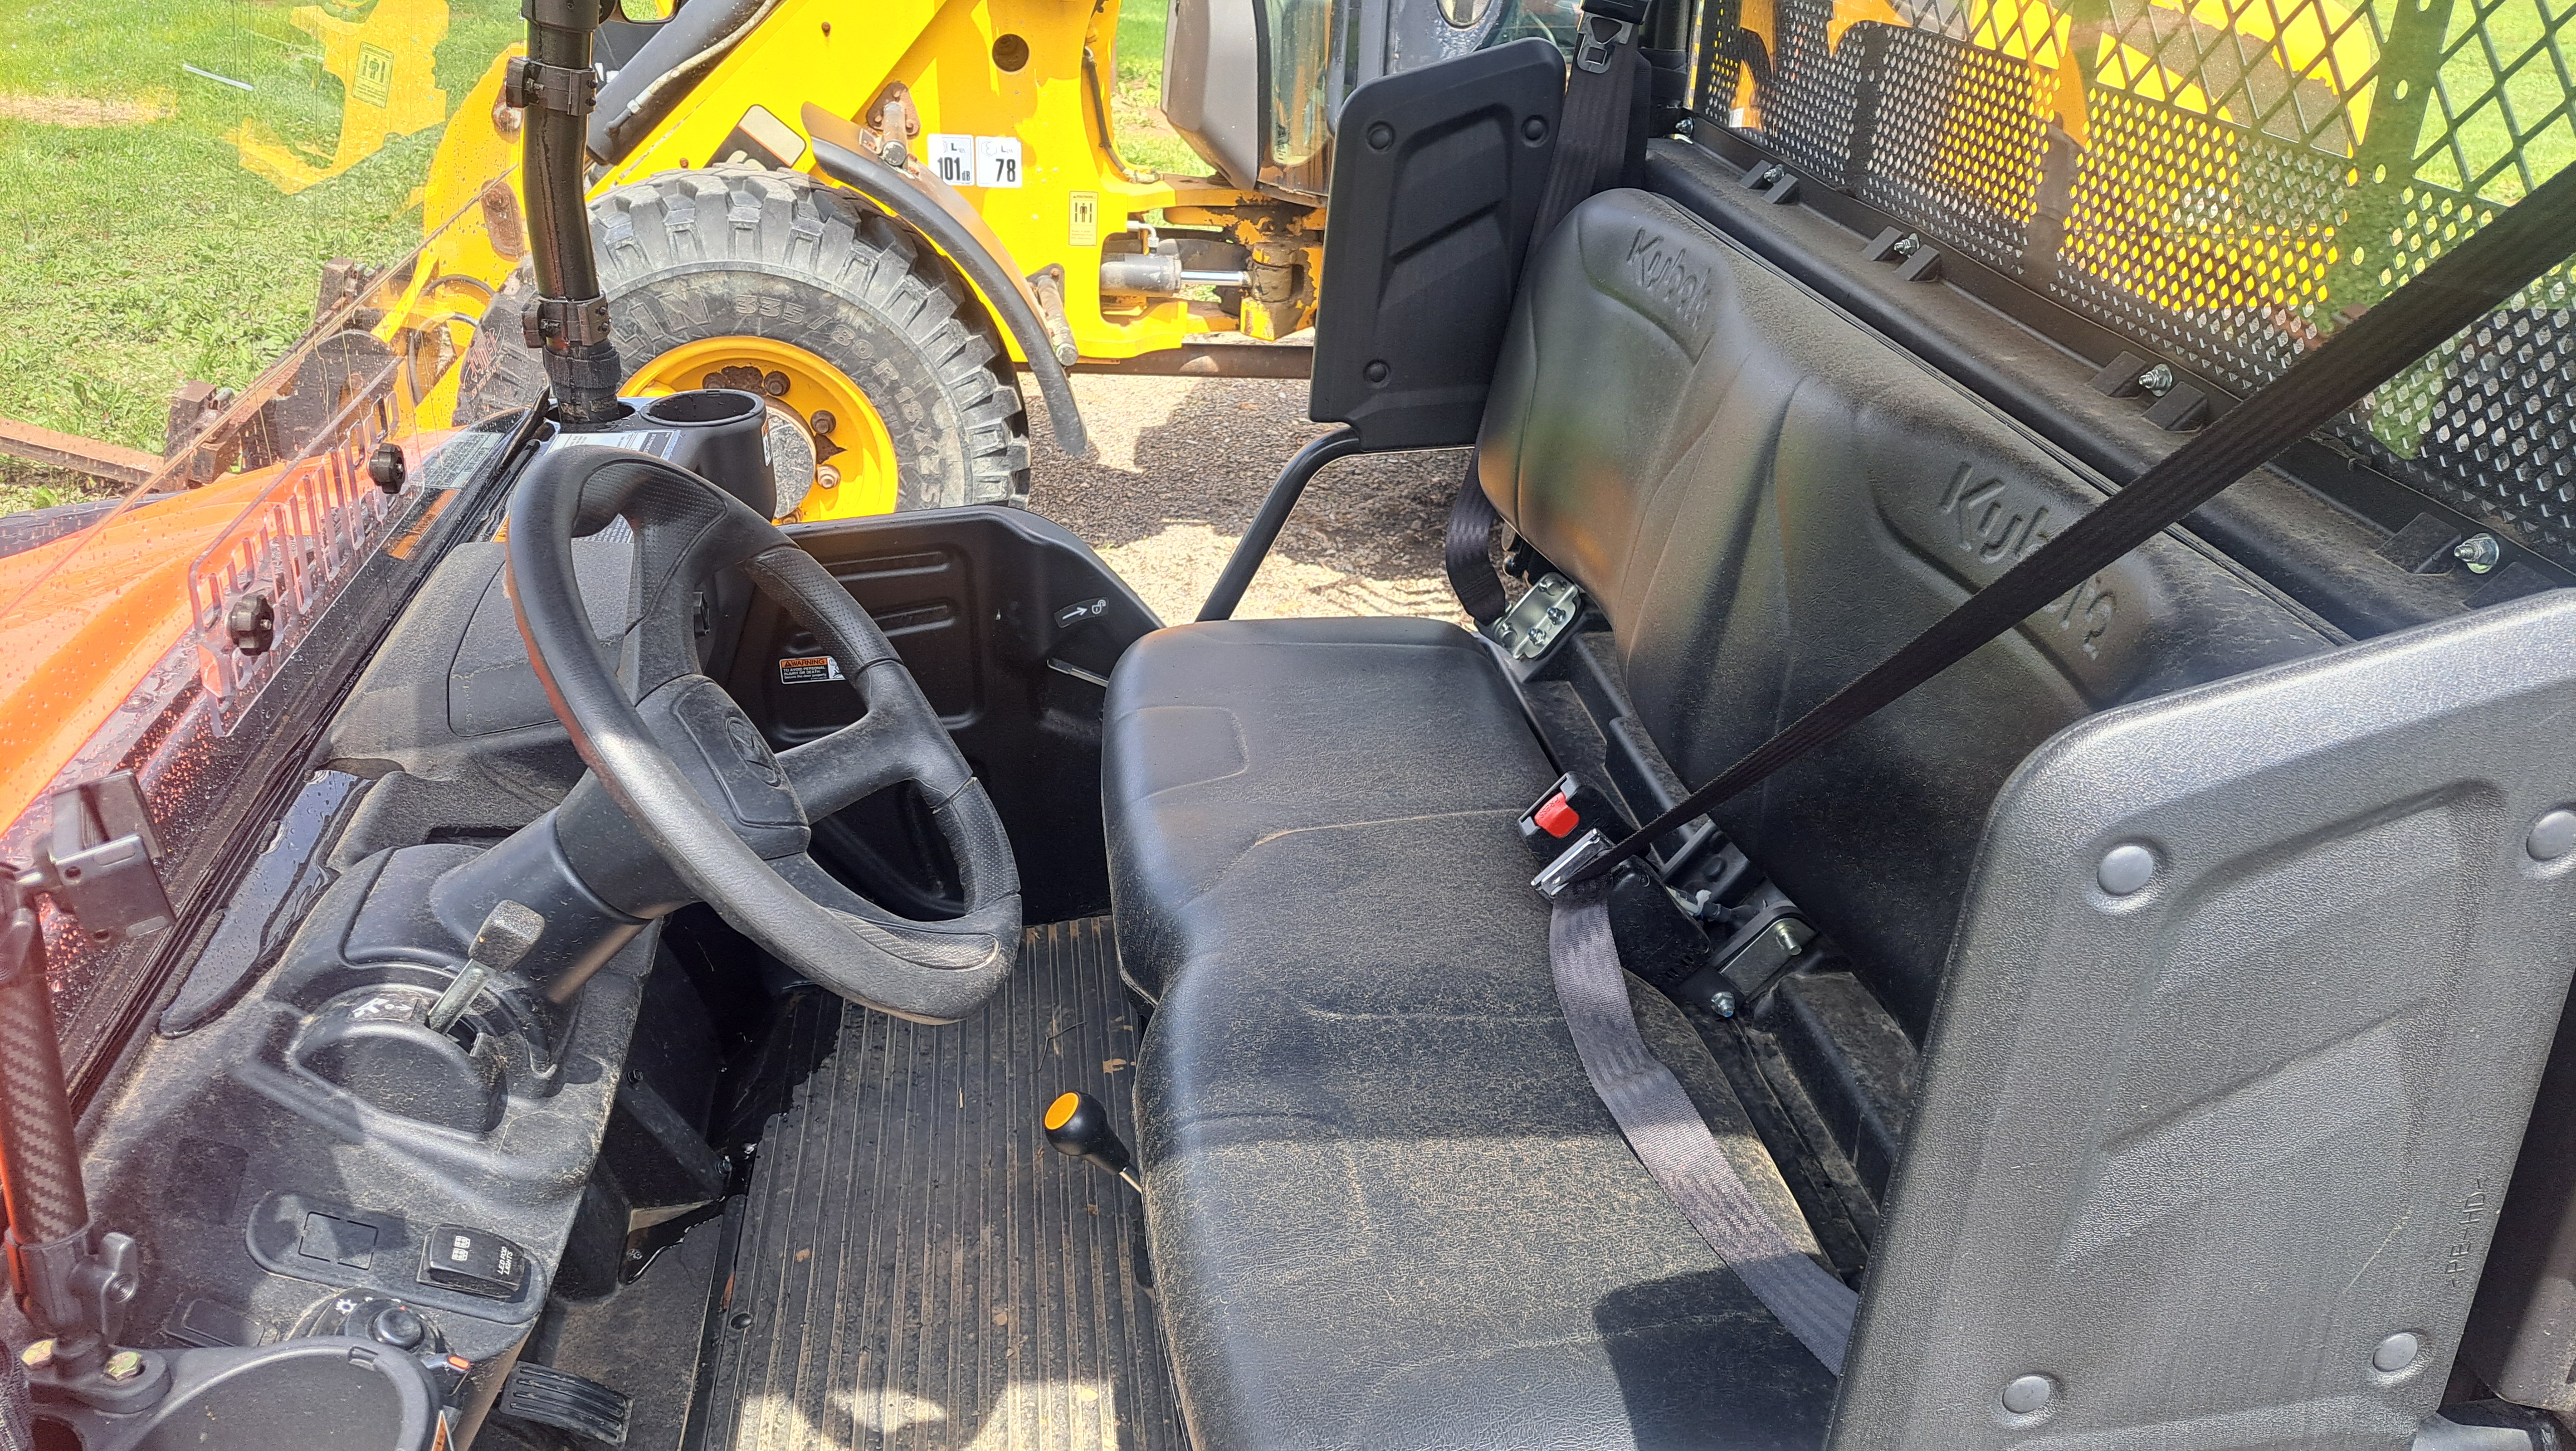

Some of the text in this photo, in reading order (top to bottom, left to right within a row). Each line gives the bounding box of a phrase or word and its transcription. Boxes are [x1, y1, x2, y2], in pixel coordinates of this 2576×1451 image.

[996, 158, 1016, 182] 78
[1940, 461, 2117, 659] Kubta
[1539, 797, 1560, 819] PRESS
[497, 1259, 505, 1275] LED
[504, 1250, 513, 1275] LIGHTS
